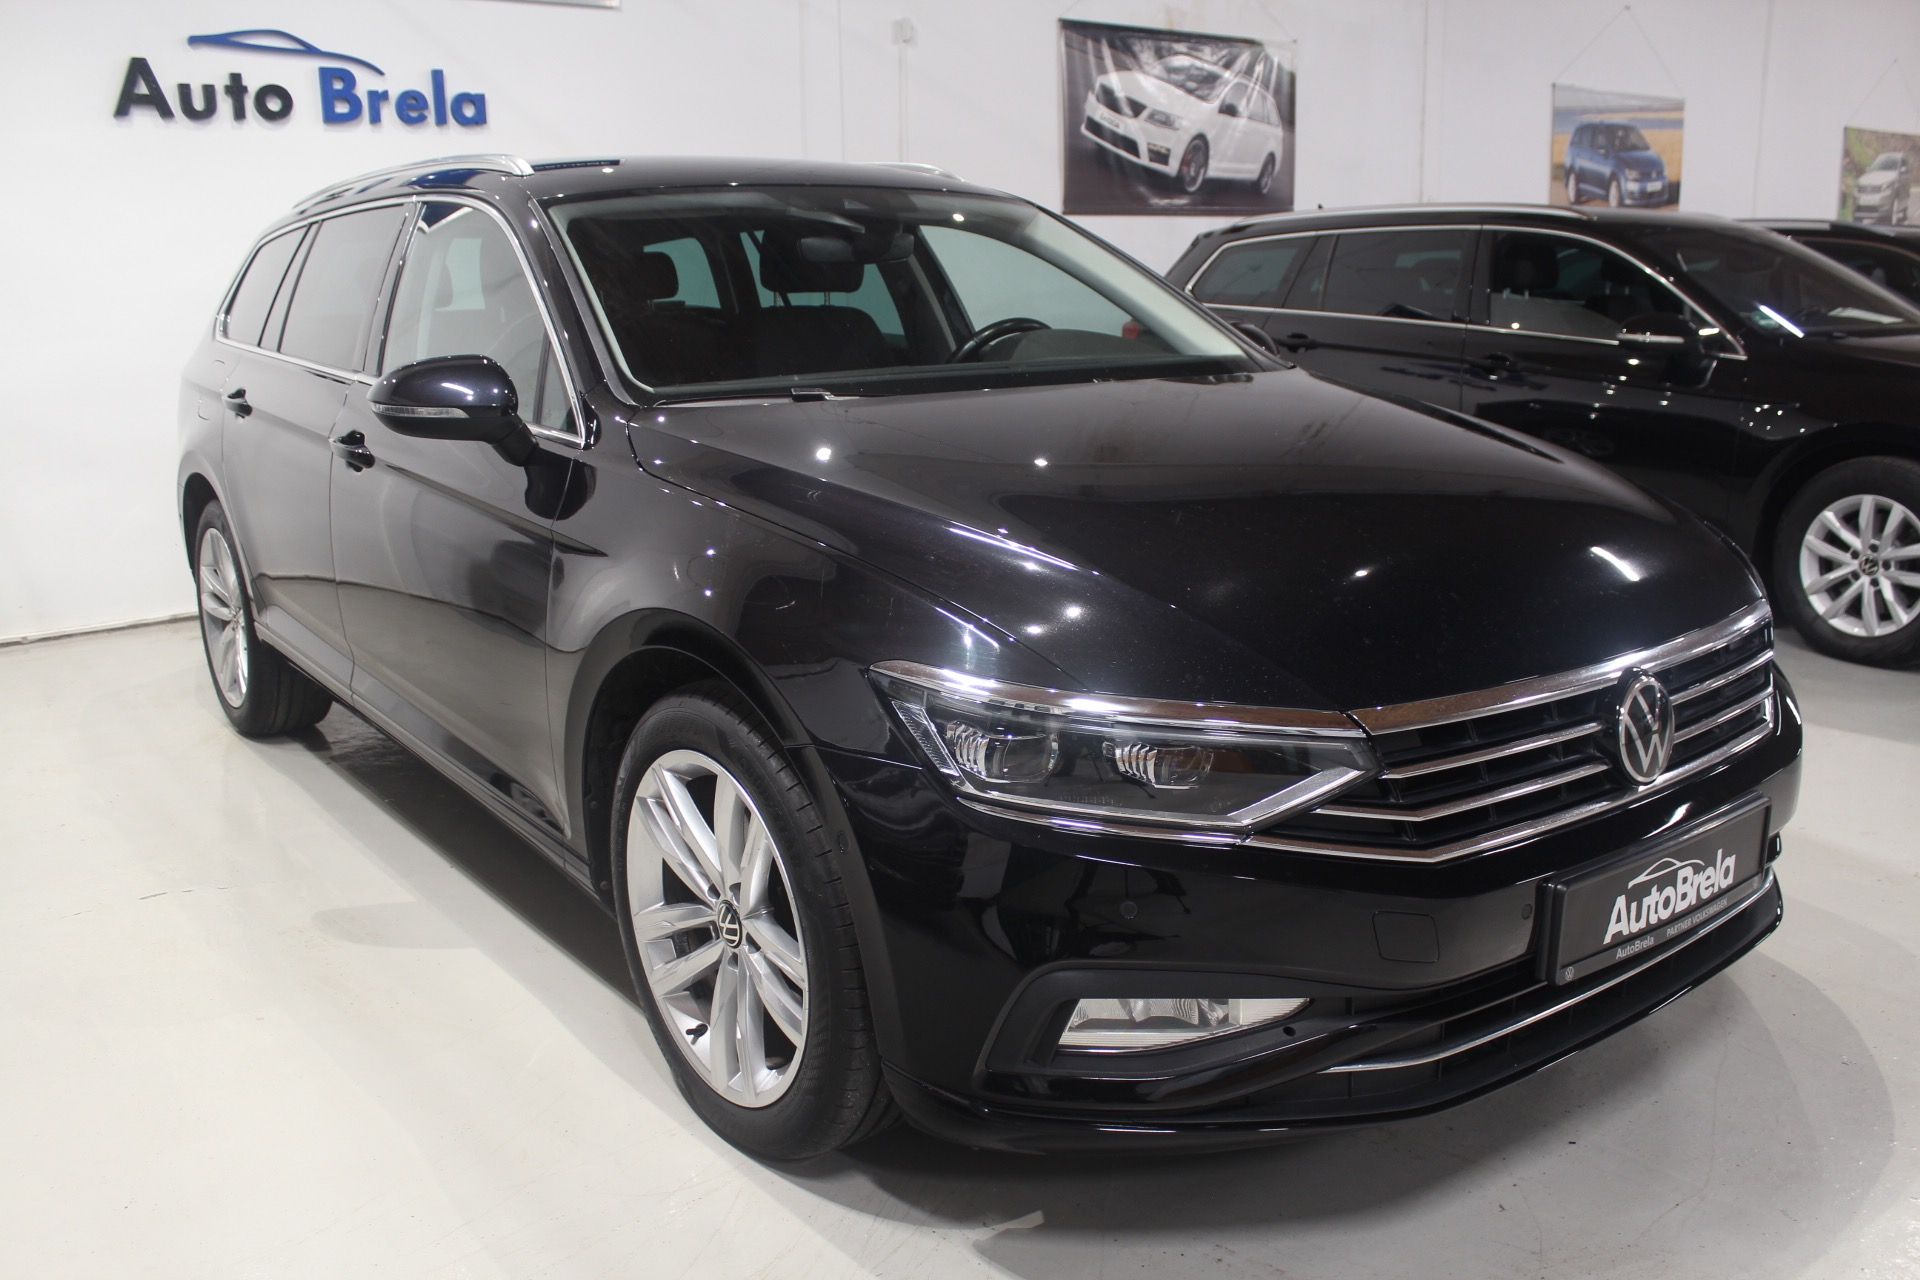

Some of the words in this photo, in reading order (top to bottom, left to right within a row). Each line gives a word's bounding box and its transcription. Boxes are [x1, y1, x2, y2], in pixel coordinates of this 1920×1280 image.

[113, 57, 293, 121] Auto
[318, 66, 488, 126] Brela
[1603, 849, 1736, 944] AutoBrela
[1615, 935, 1654, 960] AutoBrela
[1666, 917, 1693, 937] PARTNER
[1692, 898, 1728, 925] VOLKSWAGEN
